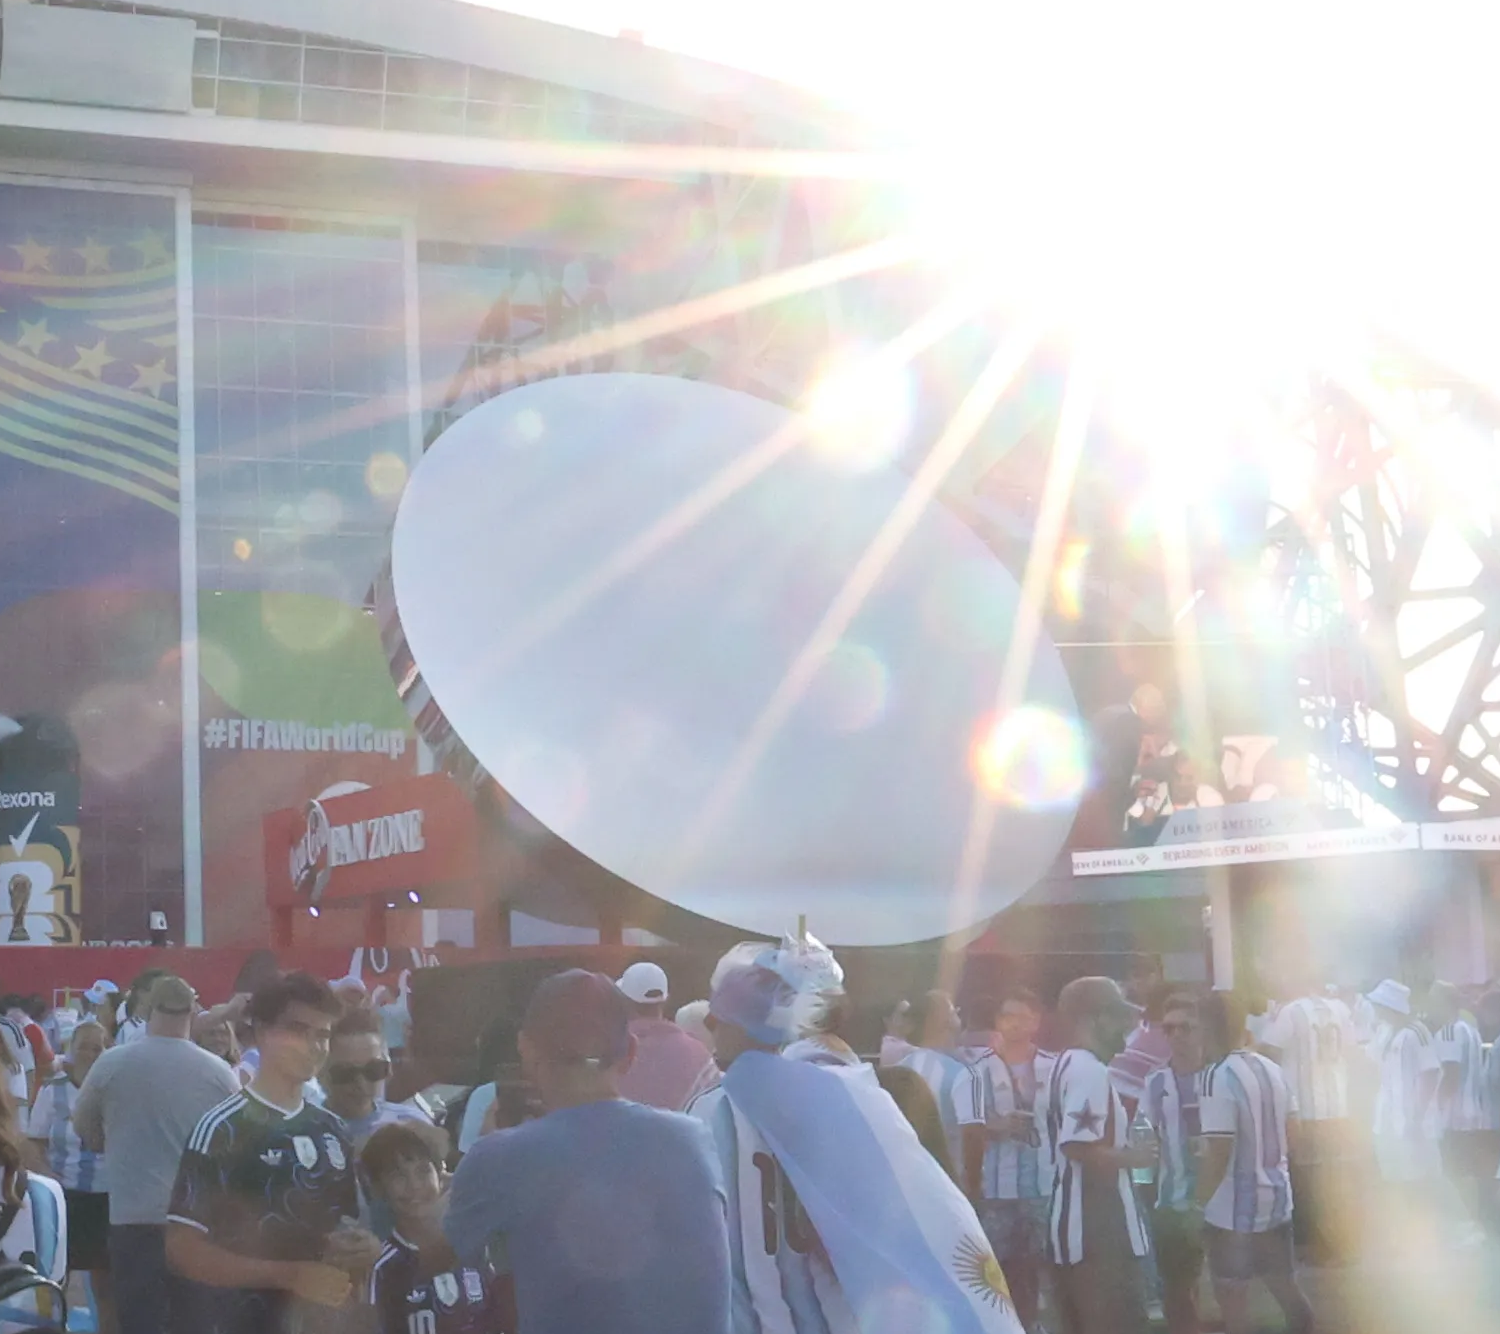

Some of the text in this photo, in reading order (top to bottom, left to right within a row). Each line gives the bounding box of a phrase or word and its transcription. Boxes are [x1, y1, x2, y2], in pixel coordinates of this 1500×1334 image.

[203, 716, 406, 758] #FIFAWorldCup
[330, 820, 366, 867] FAN
[367, 809, 425, 859] ZONE
[1173, 822, 1201, 835] BANK
[1222, 817, 1273, 833] AMERICA
[1443, 834, 1473, 843] BANK
[1474, 834, 1488, 843] OF
